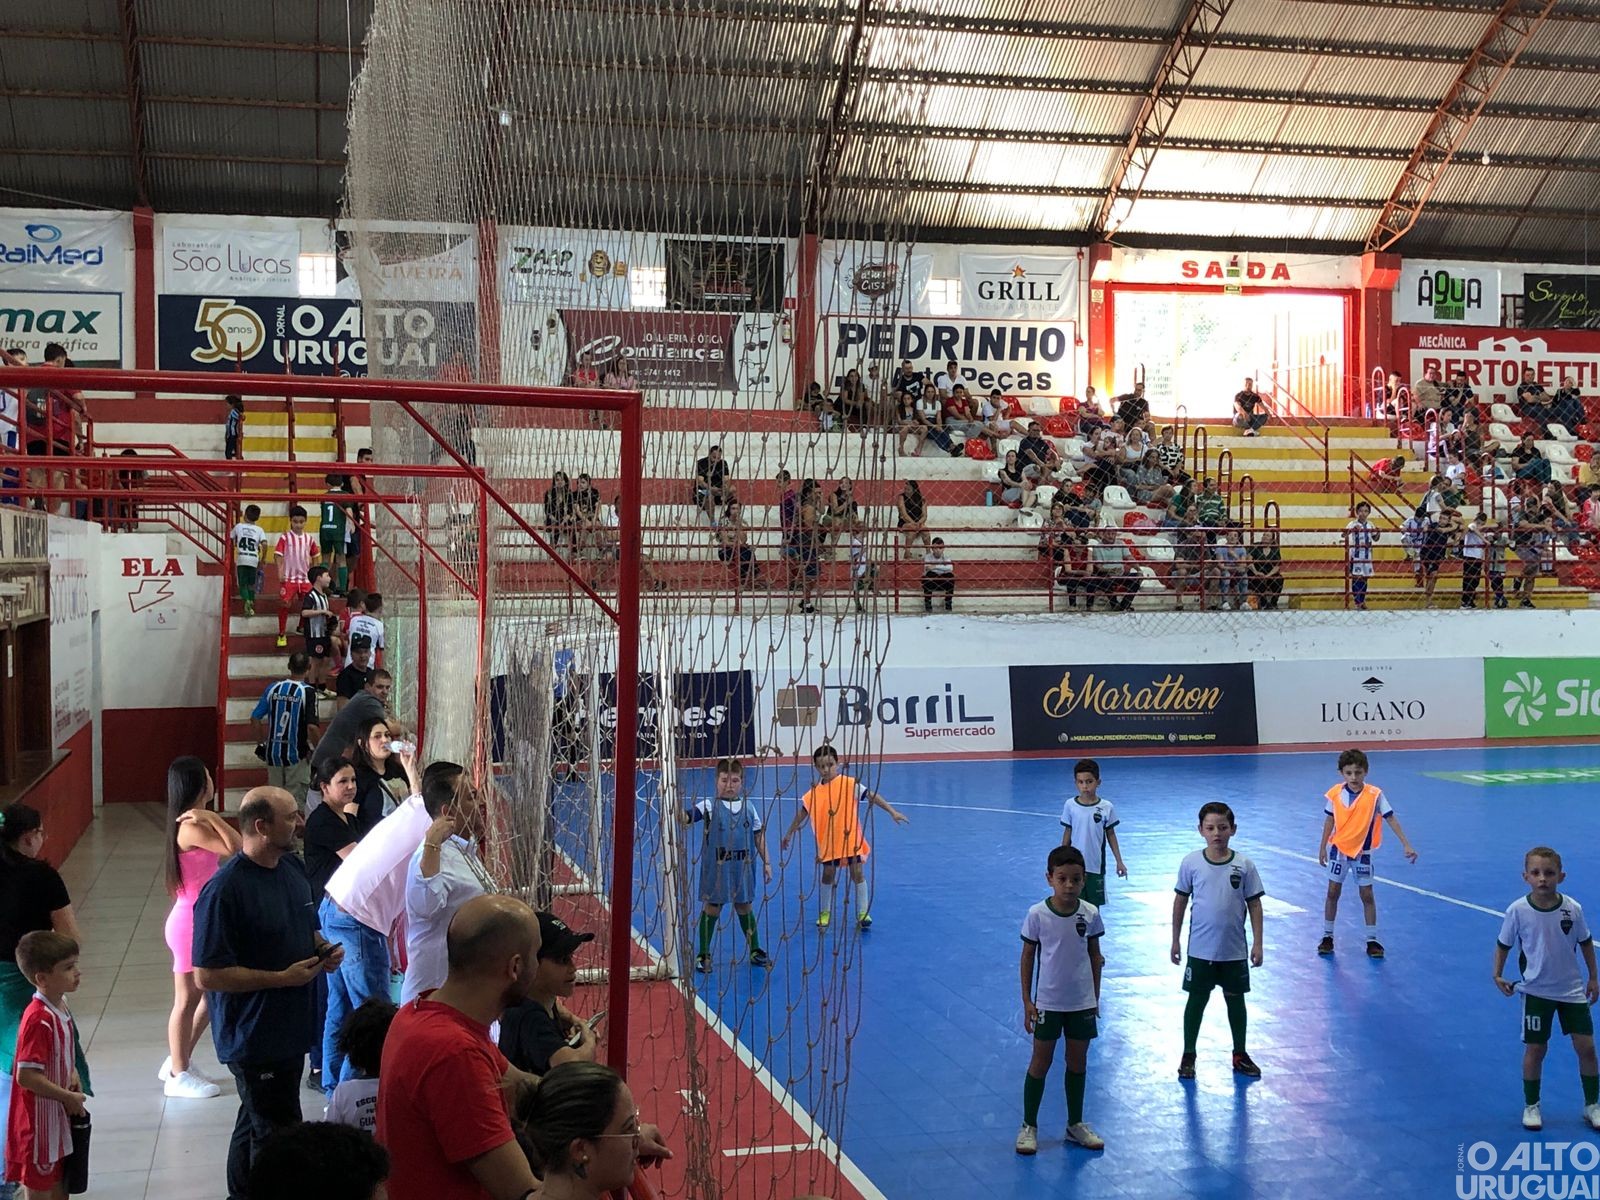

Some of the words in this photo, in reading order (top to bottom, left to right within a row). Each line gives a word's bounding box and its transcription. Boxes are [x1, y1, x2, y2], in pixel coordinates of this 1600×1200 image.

[173, 249, 221, 272] São
[228, 243, 292, 274] Lucas
[978, 281, 1060, 301] GRILL
[977, 302, 1059, 312] RESTAURANTE
[190, 298, 266, 363] 50
[227, 326, 253, 334] anos
[276, 305, 286, 338] JORNAL
[291, 304, 324, 337] O
[837, 323, 1066, 362] PEDRINHO
[1419, 334, 1467, 349] MECÂNICA
[960, 367, 1052, 392] Peças
[327, 505, 334, 522] 1
[239, 537, 256, 551] 45
[121, 558, 184, 577] ELA
[1074, 673, 1224, 716] Marathon
[1321, 699, 1425, 724] LUGANO
[279, 711, 290, 737] 9
[905, 725, 996, 740] Supermercado
[1346, 728, 1403, 737] GRAMADO
[1526, 1015, 1541, 1031] 10
